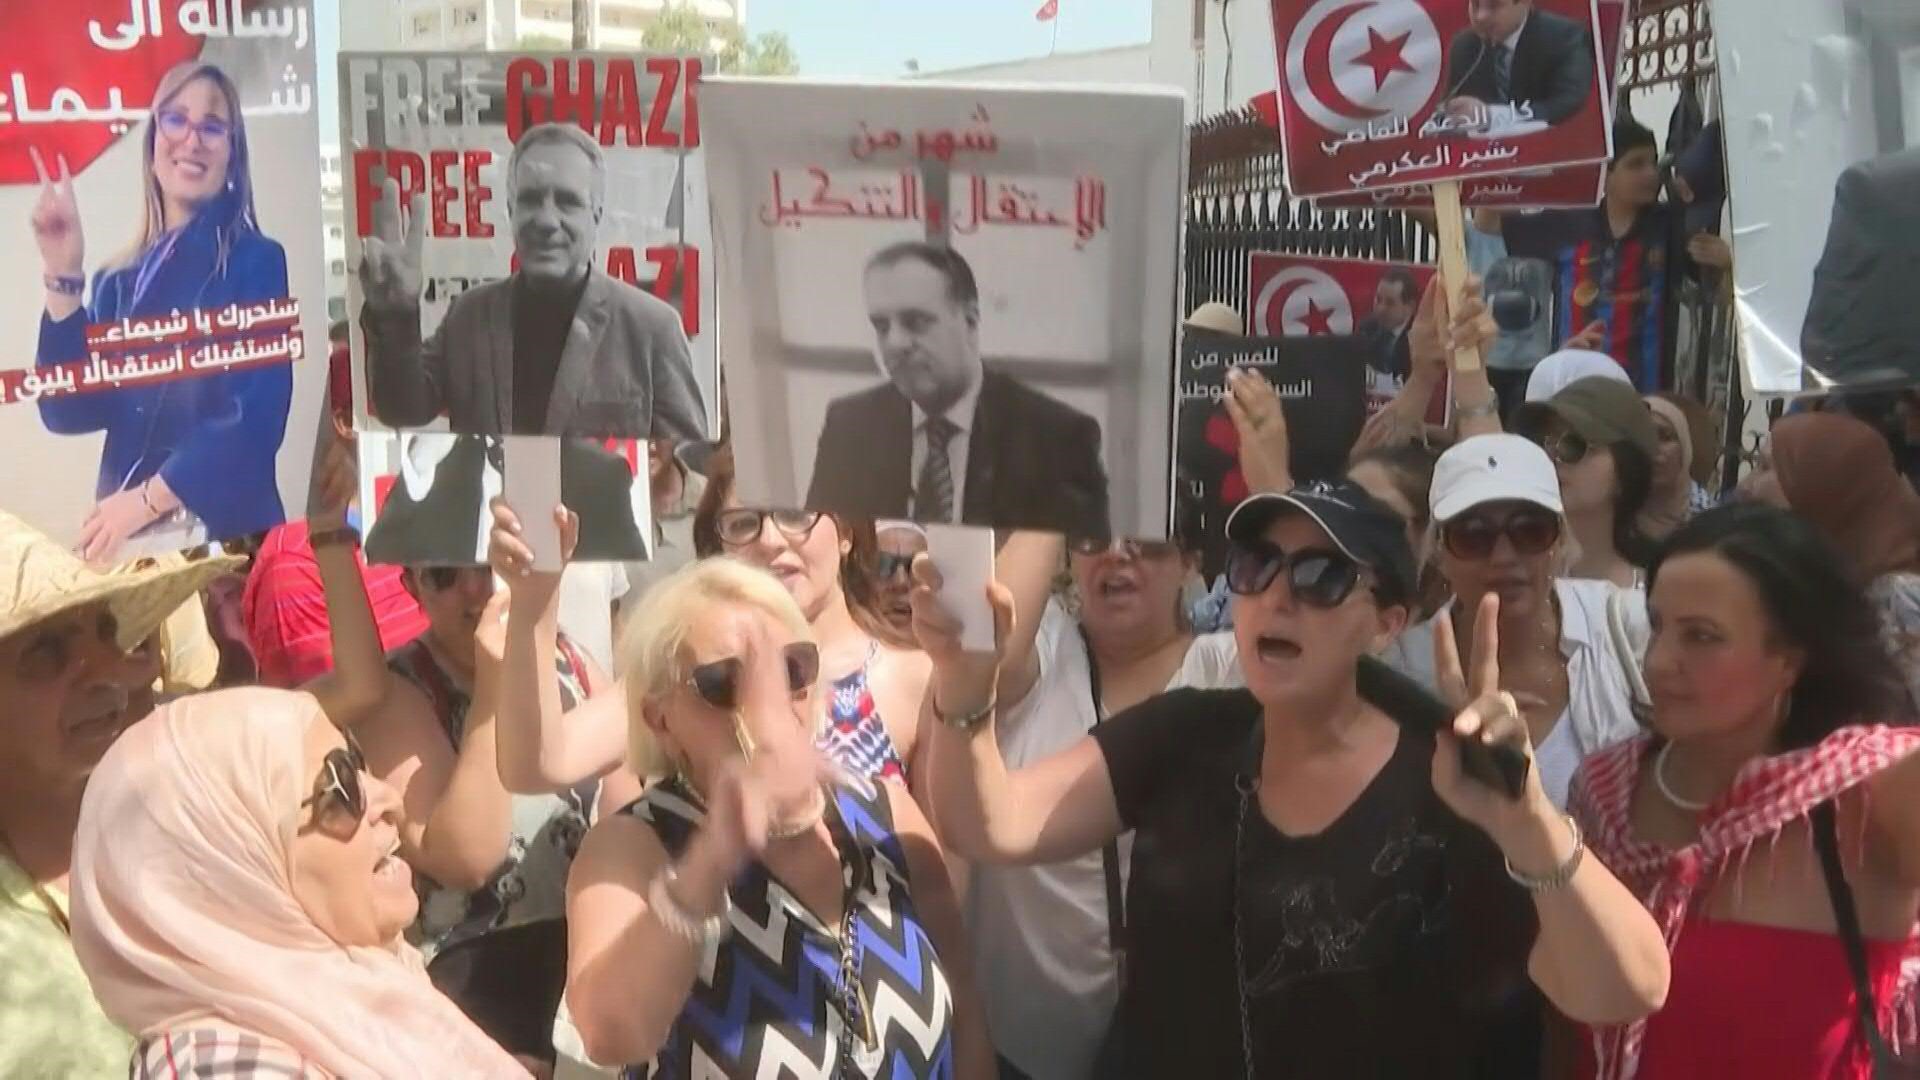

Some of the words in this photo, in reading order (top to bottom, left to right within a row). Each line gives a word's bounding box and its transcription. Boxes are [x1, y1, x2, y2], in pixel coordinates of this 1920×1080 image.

[350, 58, 493, 148] FREE
[507, 56, 701, 148] GHAZI
[851, 120, 902, 160] من
[1459, 140, 1519, 169] بشير
[1348, 144, 1450, 189] العكرمي
[354, 150, 494, 239] FREE
[194, 306, 212, 336] يا
[1190, 349, 1219, 370] من
